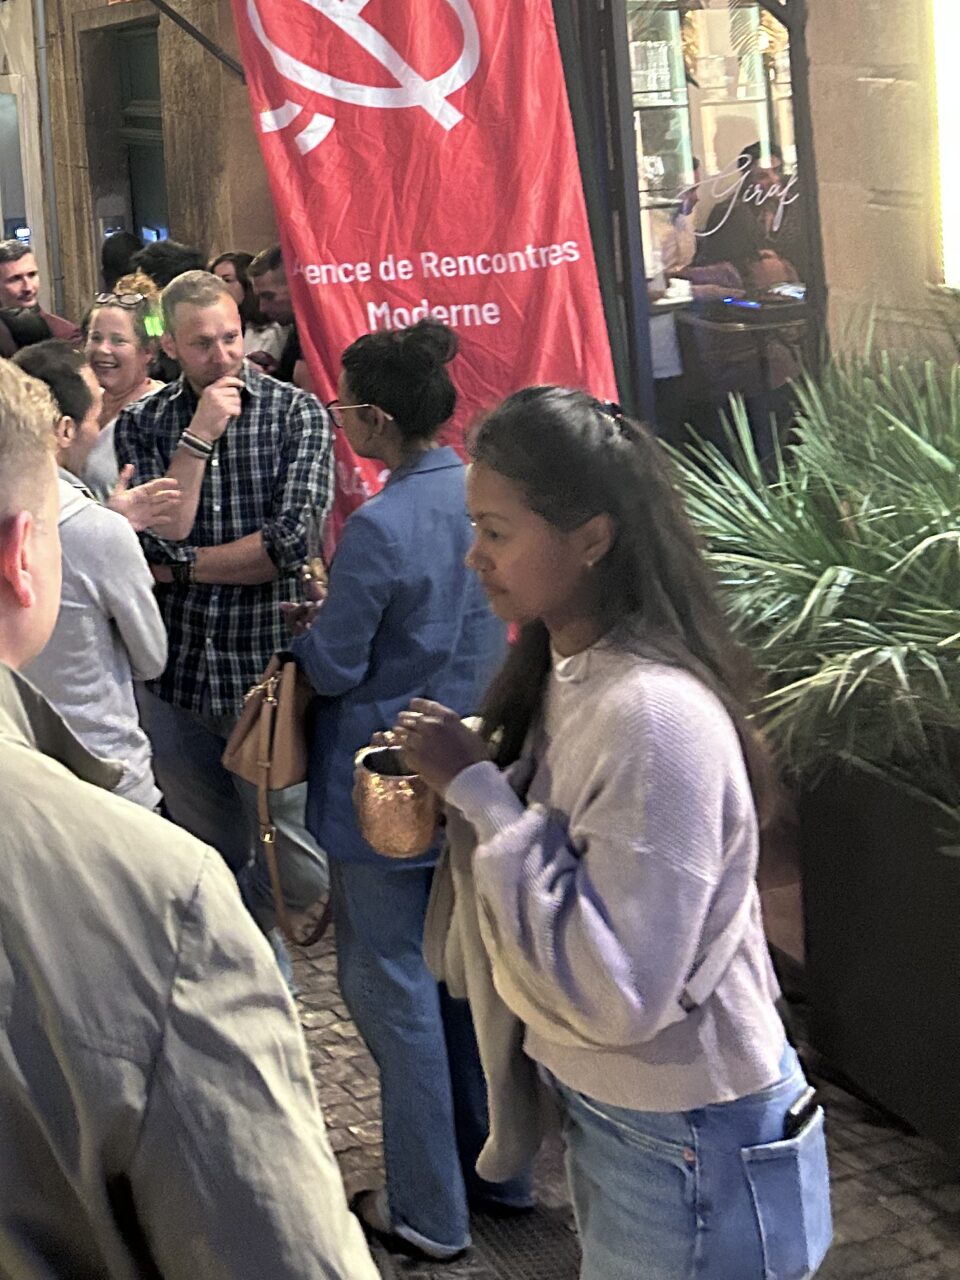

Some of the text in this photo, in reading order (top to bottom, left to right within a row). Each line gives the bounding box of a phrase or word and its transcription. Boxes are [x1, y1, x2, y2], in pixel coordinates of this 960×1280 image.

[379, 254, 414, 281] de
[420, 240, 581, 279] Rencontres
[367, 298, 501, 331] Moderne
